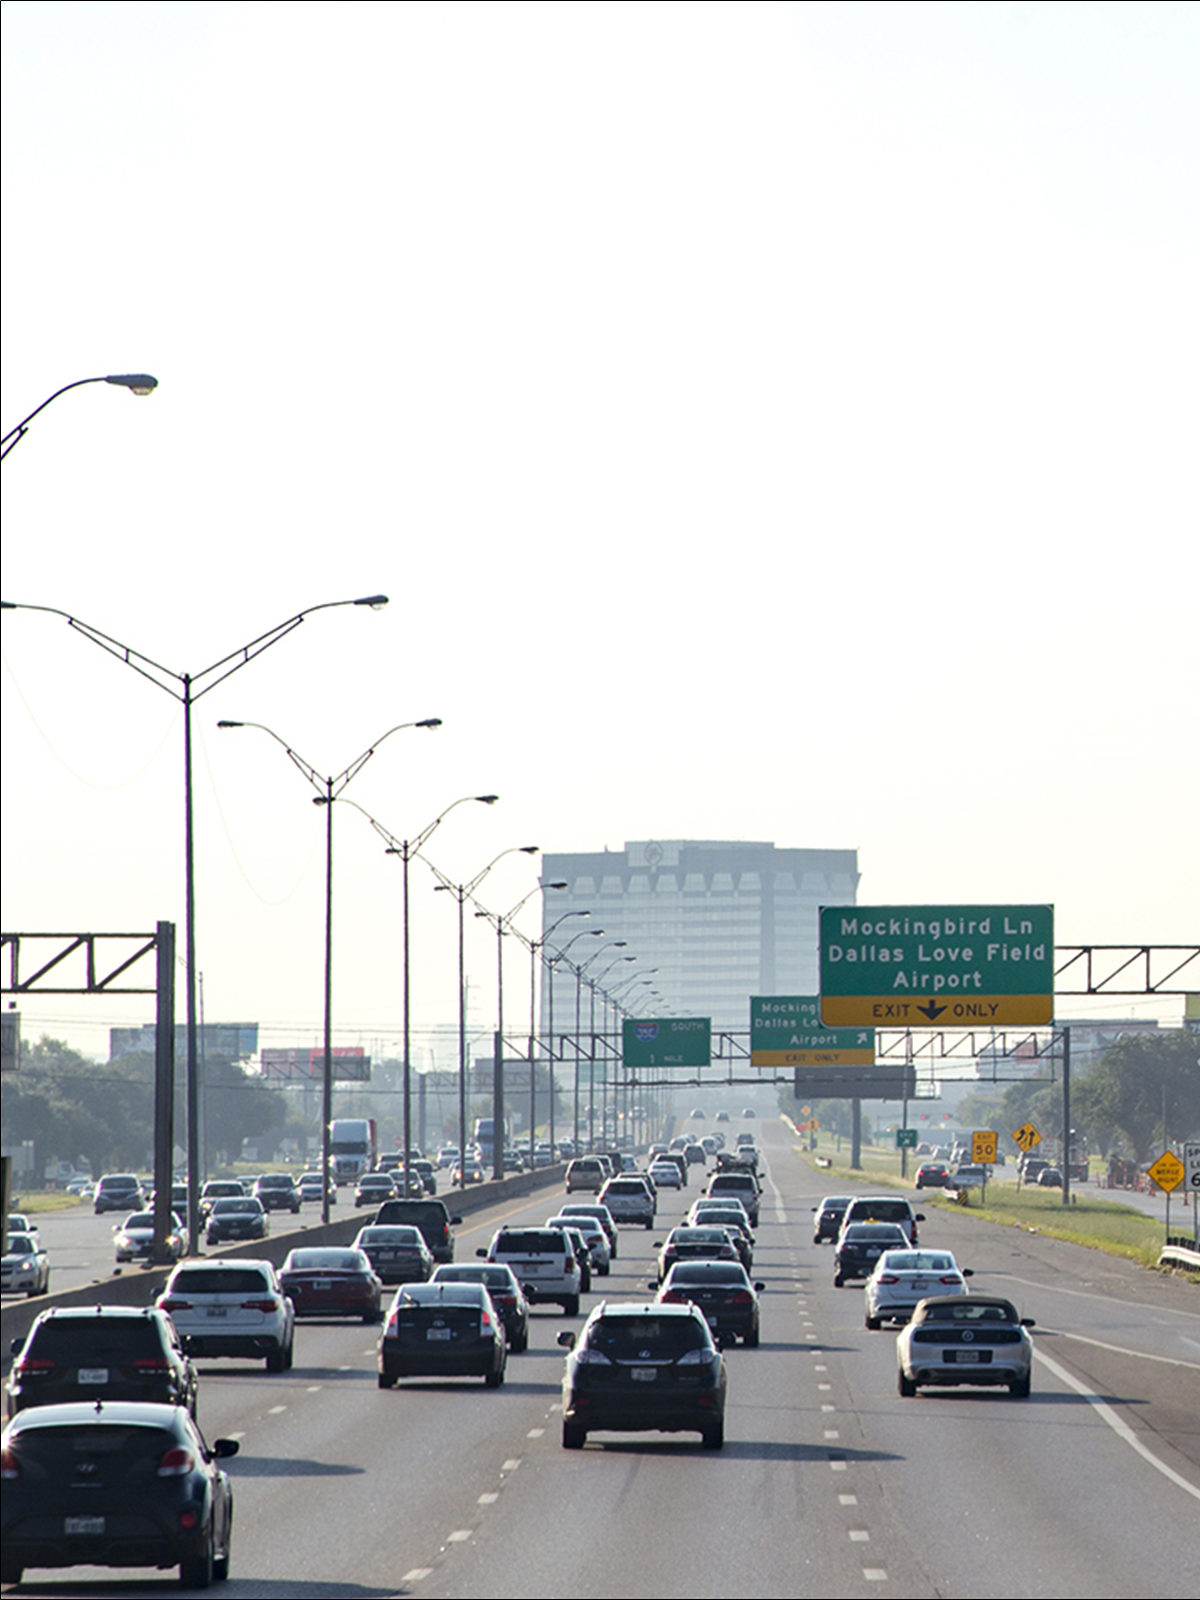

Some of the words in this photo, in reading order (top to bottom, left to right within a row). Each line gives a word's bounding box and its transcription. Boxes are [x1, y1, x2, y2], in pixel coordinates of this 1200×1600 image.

[840, 917, 991, 940] Mockingbird
[1003, 917, 1033, 935] Ln
[828, 944, 905, 963] Dallas
[917, 944, 974, 962] Love
[986, 943, 1045, 961] Field
[892, 970, 983, 992] Airport
[761, 1003, 816, 1016] Mocking
[872, 1003, 911, 1018] EXIT
[952, 1003, 1000, 1017] ONLY
[670, 1021, 705, 1032] SOUTH
[754, 1018, 797, 1028] Dallas
[802, 1018, 819, 1028] Lo
[790, 1034, 838, 1047] Airport
[648, 1053, 655, 1065] 1
[663, 1054, 685, 1063] MILE
[785, 1053, 807, 1062] EXIT
[814, 1053, 840, 1062] ONLY
[975, 1144, 994, 1156] 50
[1156, 1168, 1180, 1176] MERGE
